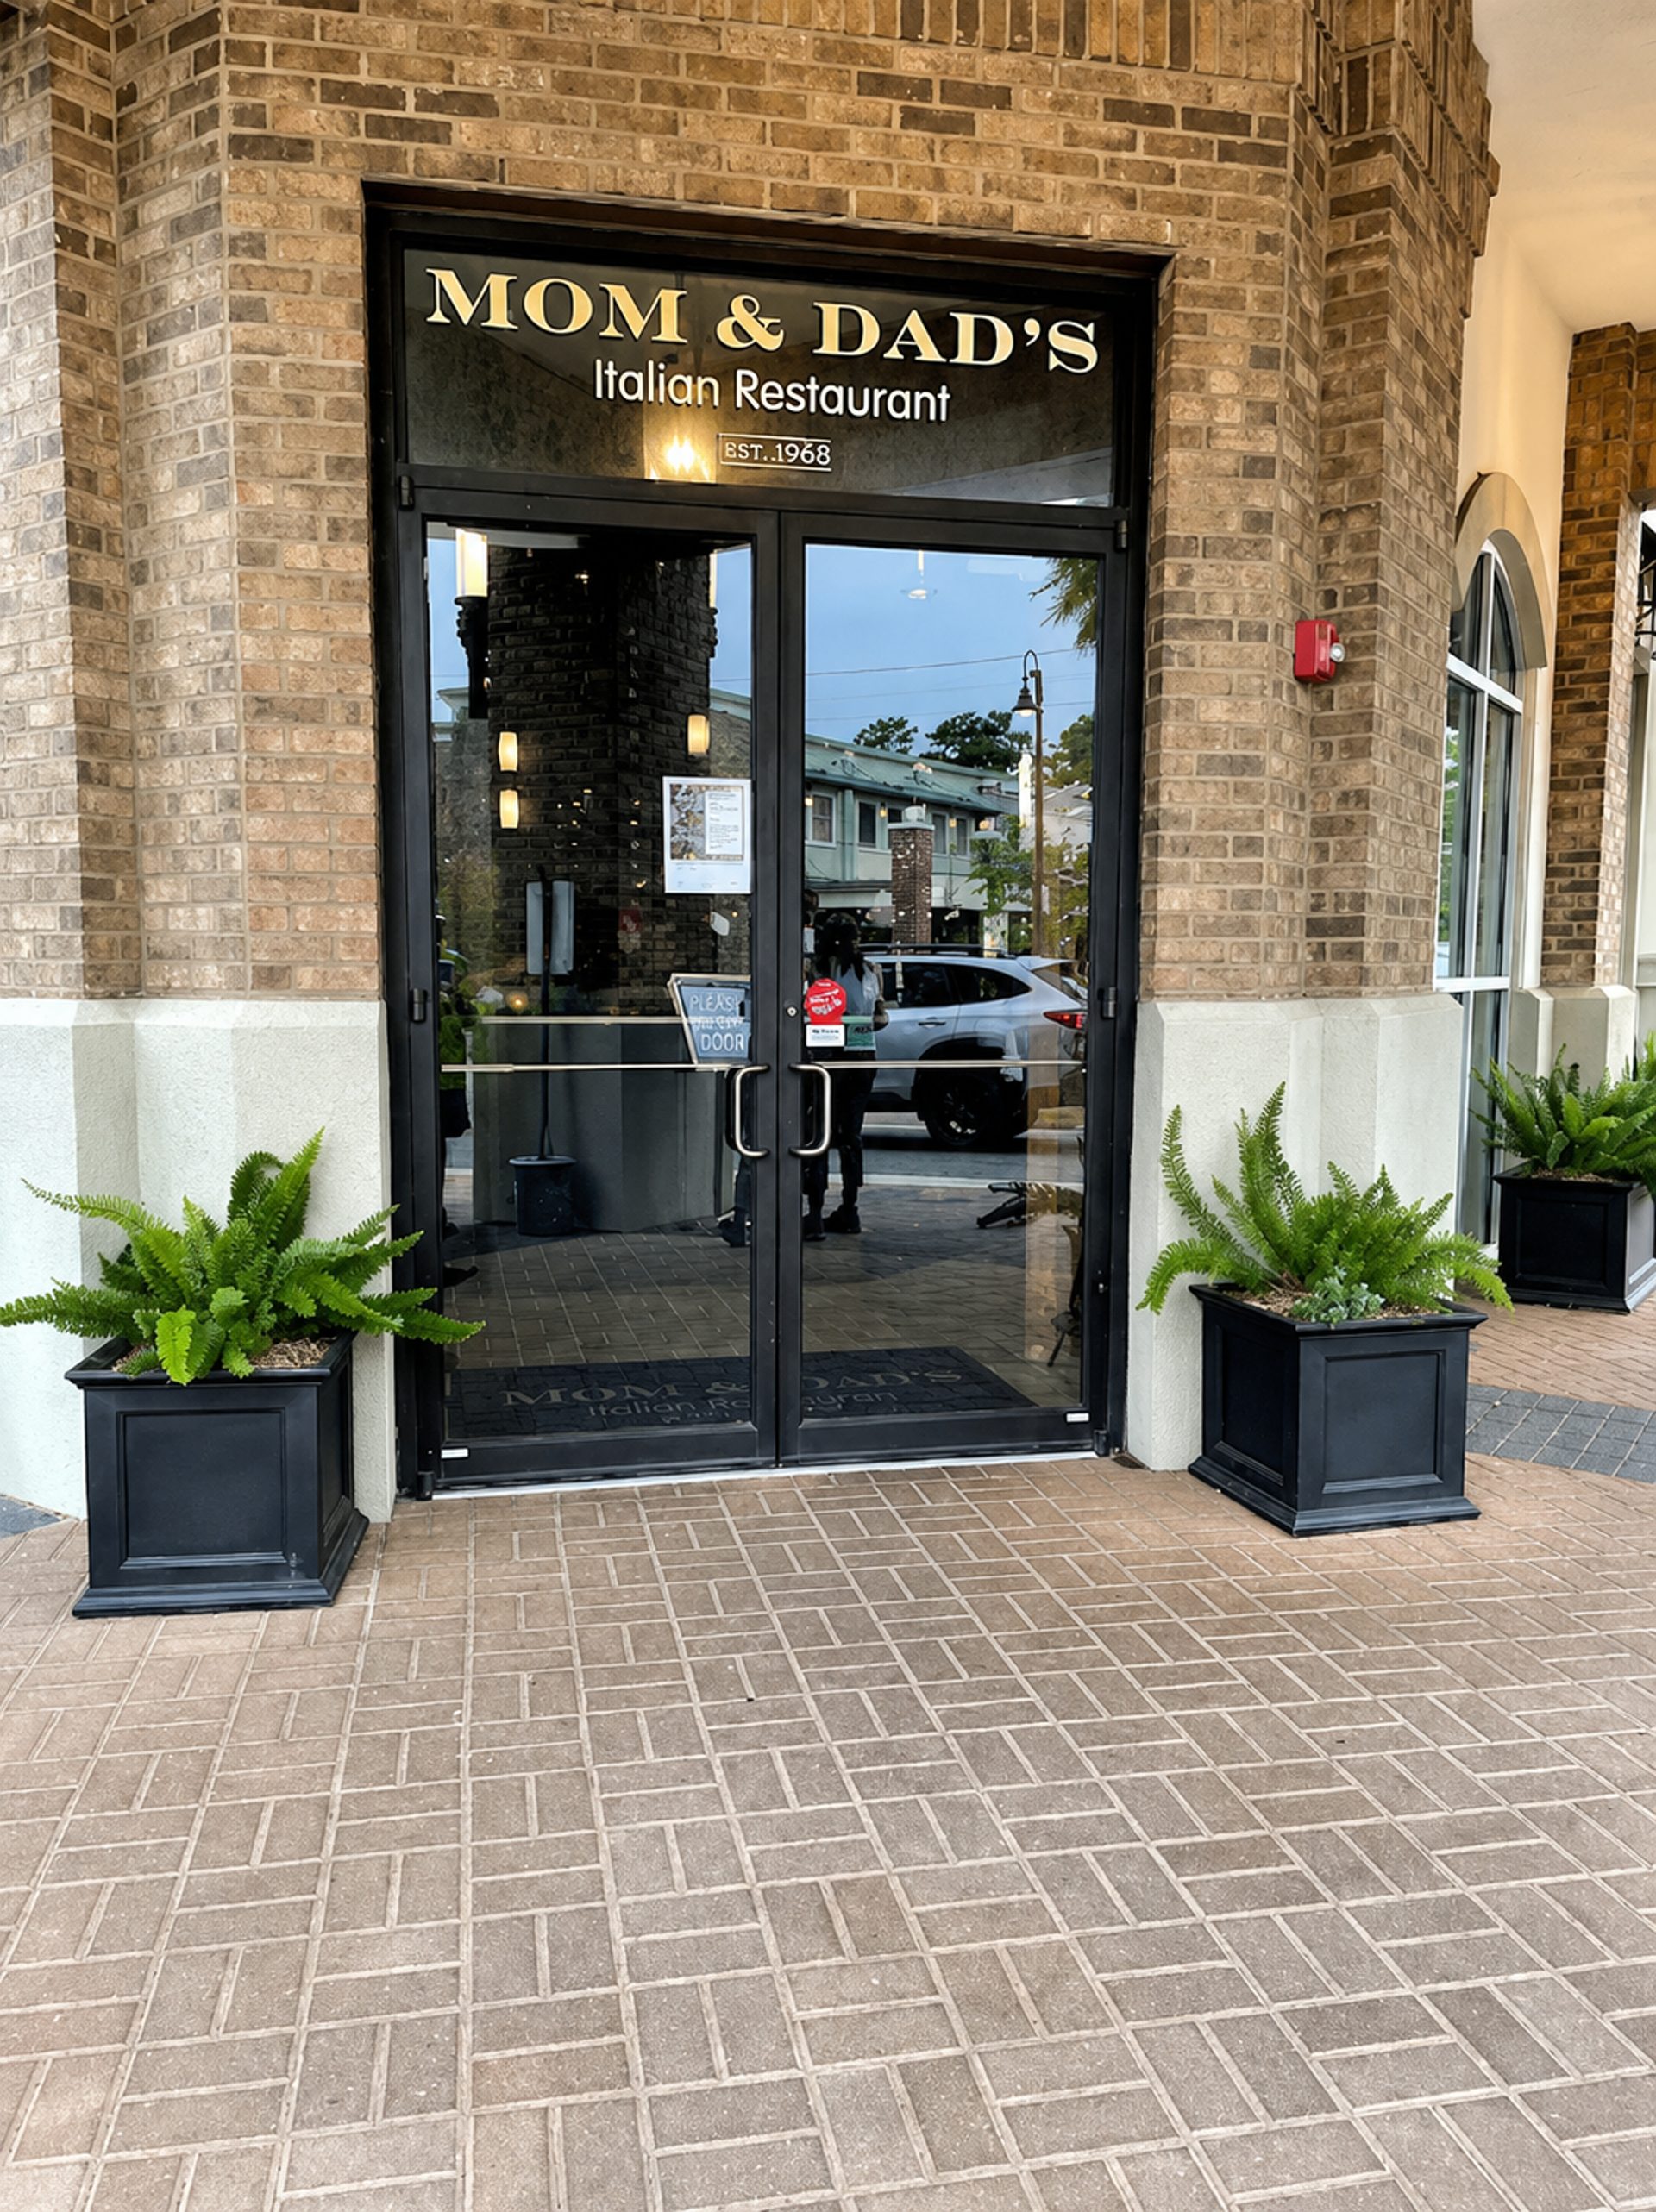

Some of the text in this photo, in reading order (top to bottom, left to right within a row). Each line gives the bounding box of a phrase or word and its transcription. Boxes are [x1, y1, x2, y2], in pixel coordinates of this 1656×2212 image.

[425, 267, 1099, 373] MOM & DAD'S
[593, 359, 950, 422] Italian Restaurant
[701, 1031, 744, 1051] DOOR
[499, 1383, 687, 1407] MOM
[589, 1400, 696, 1416] Italian
